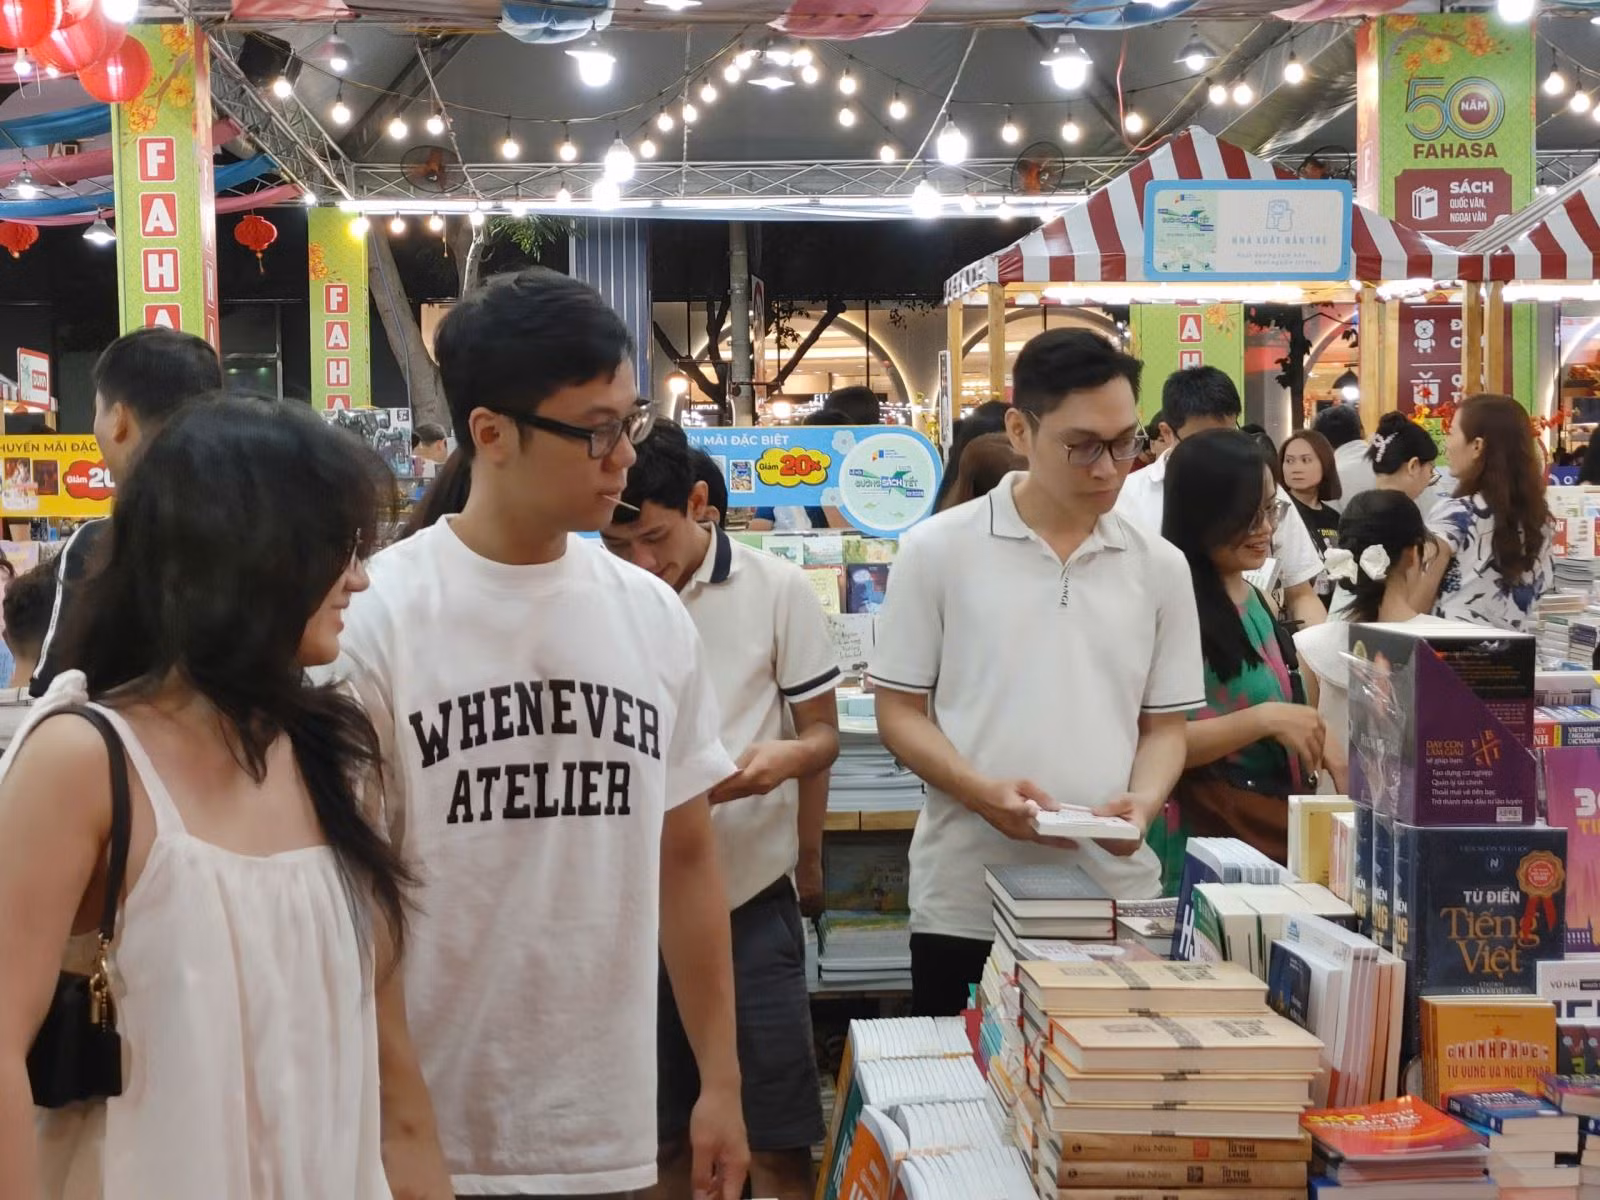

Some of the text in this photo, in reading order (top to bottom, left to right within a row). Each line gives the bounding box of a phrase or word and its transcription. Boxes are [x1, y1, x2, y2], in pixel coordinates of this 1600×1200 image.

[1405, 76, 1505, 141] 50
[1461, 99, 1488, 111] NĂM
[1413, 143, 1498, 159] FAHASA
[1450, 179, 1494, 194] SÁCH
[1450, 195, 1468, 209] QUỐC
[44, 441, 67, 452] MÃI
[71, 441, 97, 454] ĐẶC
[704, 434, 727, 446] MÃI
[731, 433, 758, 447] ĐẶC
[761, 433, 790, 447] BIỆT
[409, 679, 661, 768] WHENEVER
[447, 760, 631, 824] ATELIER
[1486, 887, 1520, 904] ĐIỂN
[1456, 939, 1523, 979] Việt
